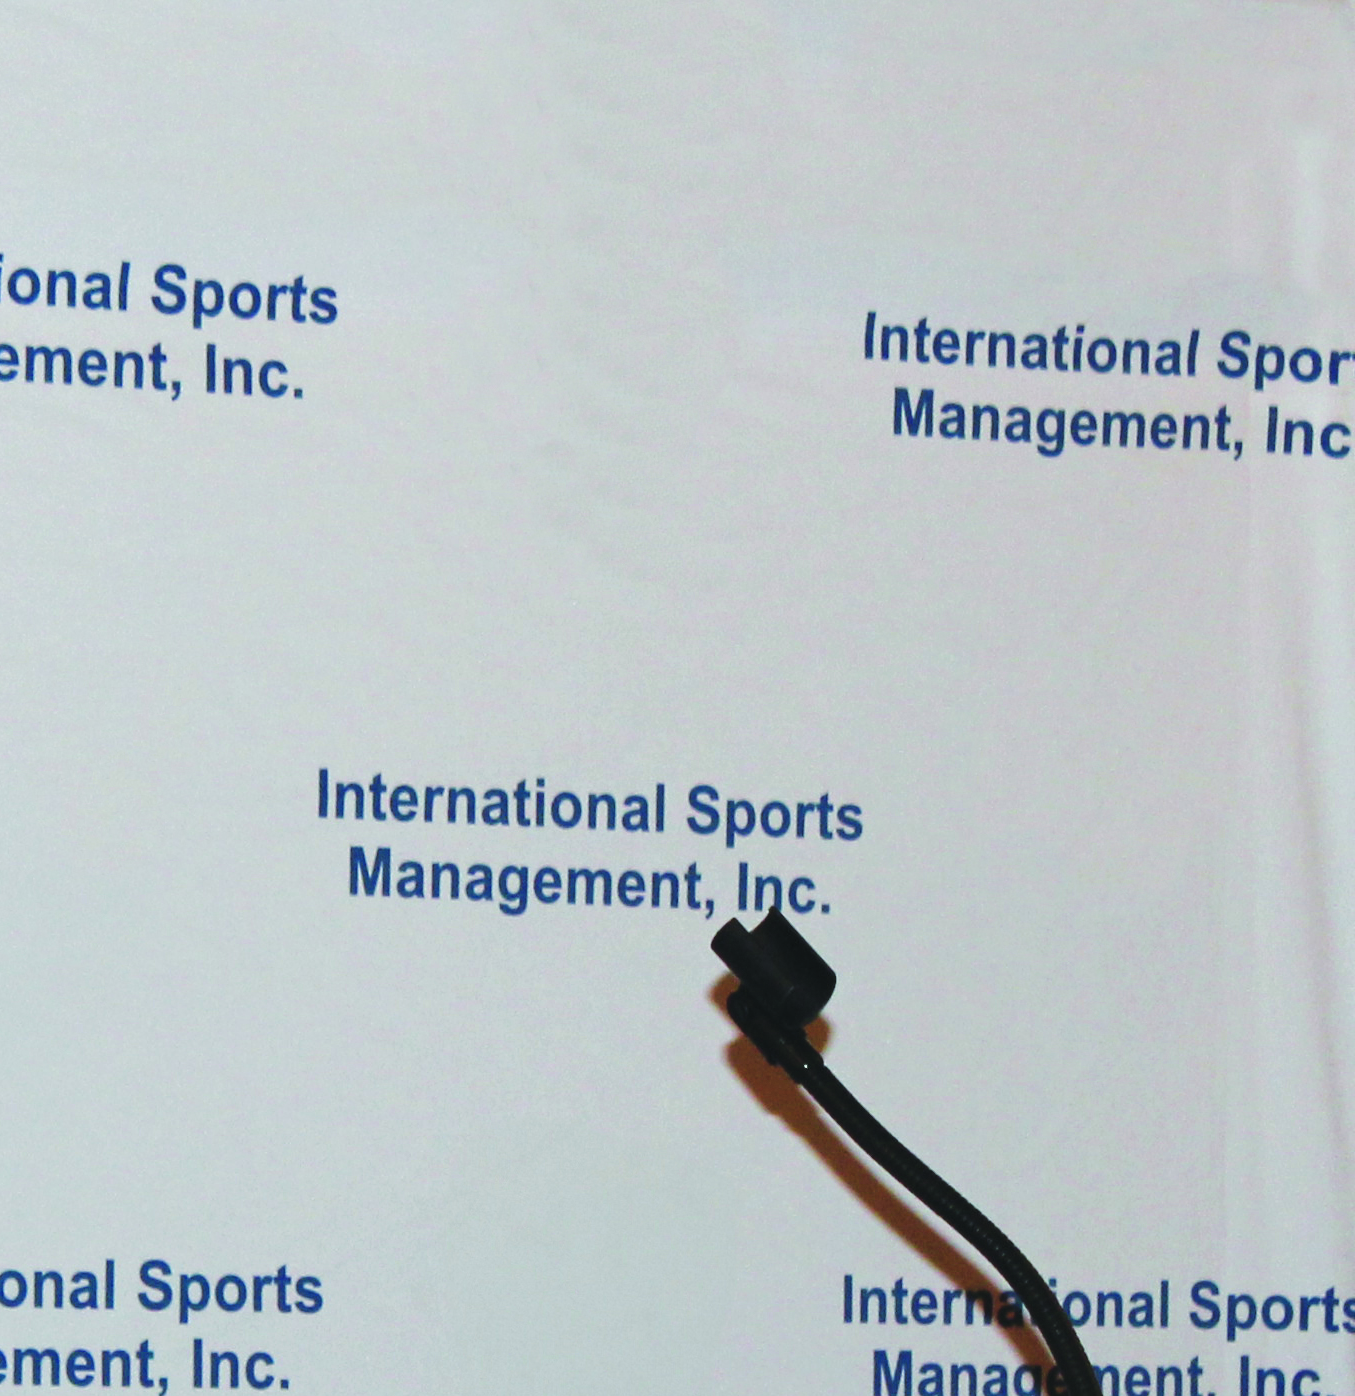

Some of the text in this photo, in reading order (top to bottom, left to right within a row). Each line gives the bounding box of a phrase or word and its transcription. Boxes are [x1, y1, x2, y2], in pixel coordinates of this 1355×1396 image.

[150, 263, 339, 330] Sports
[205, 342, 304, 400] Inc.
[863, 310, 1355, 392] International Spor
[892, 386, 1352, 462] Management, Inc
[318, 767, 864, 849] International Sports
[348, 845, 832, 920] Management, Inc.
[137, 1258, 324, 1325] Sports
[192, 1337, 290, 1391] Inc.
